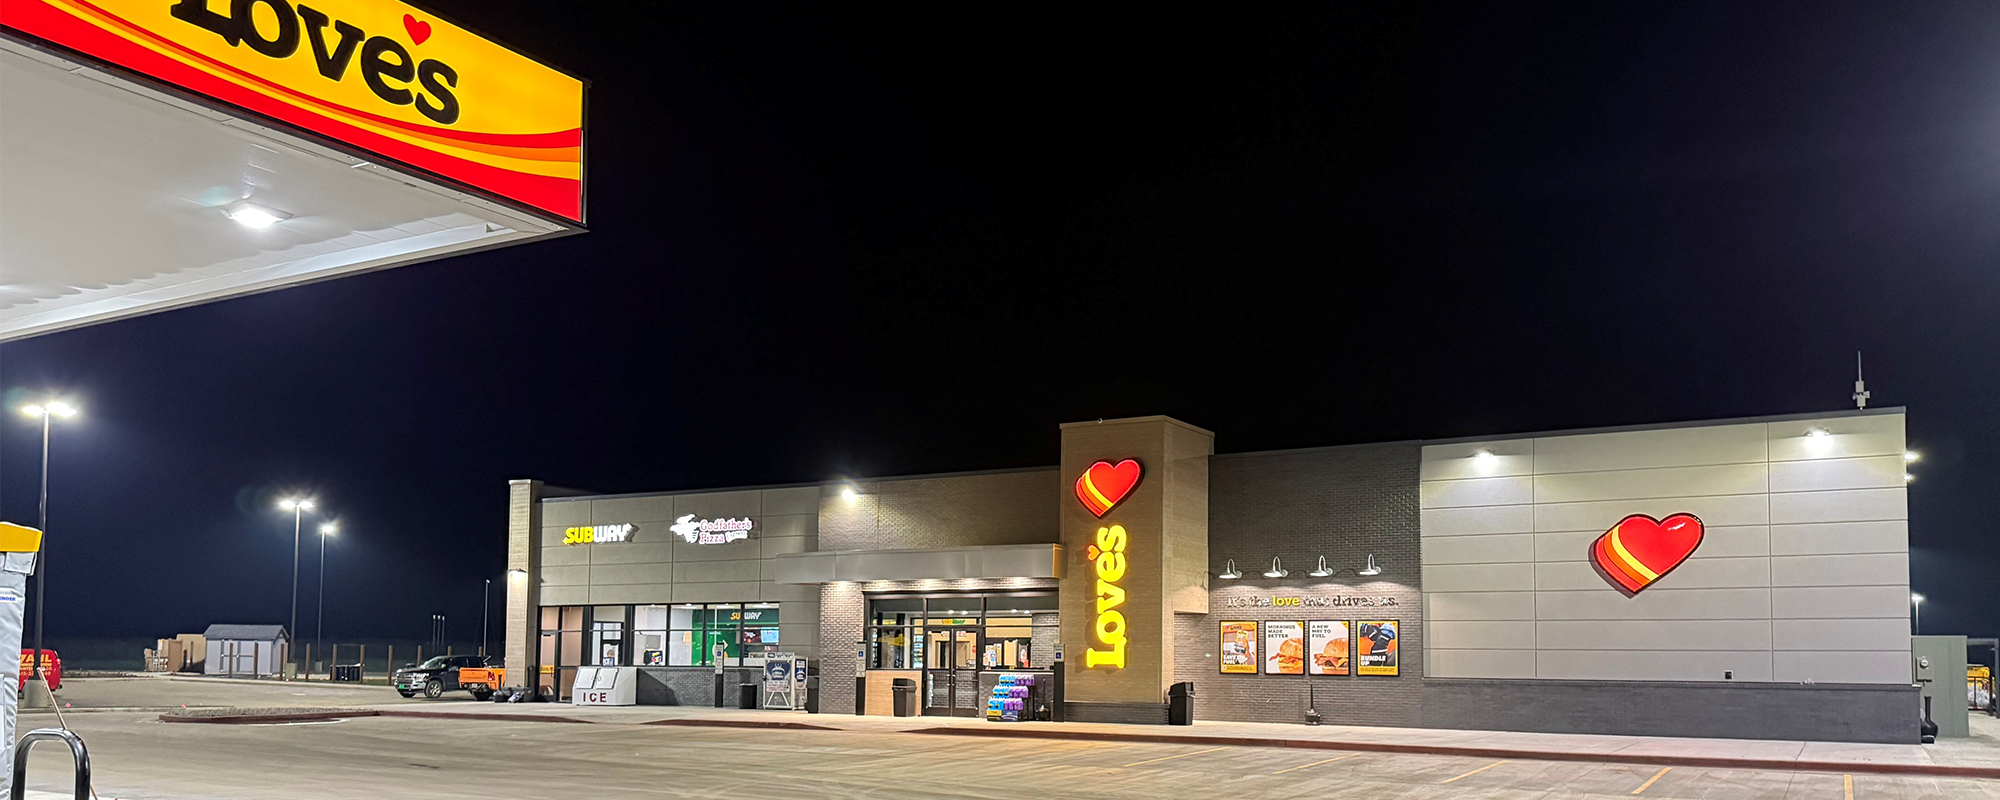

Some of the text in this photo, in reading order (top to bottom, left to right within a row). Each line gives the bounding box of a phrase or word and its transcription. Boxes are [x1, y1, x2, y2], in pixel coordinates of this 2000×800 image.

[700, 517, 752, 531] Godfather's
[563, 523, 632, 545] SUBWAY
[700, 533, 725, 543] Pizza
[1227, 596, 1246, 607] It's
[1250, 595, 1270, 607] the
[1272, 595, 1300, 607] love
[1303, 595, 1329, 607] that
[1333, 595, 1375, 607] drives
[730, 612, 762, 620] SUWAY
[583, 692, 607, 702] ICE
